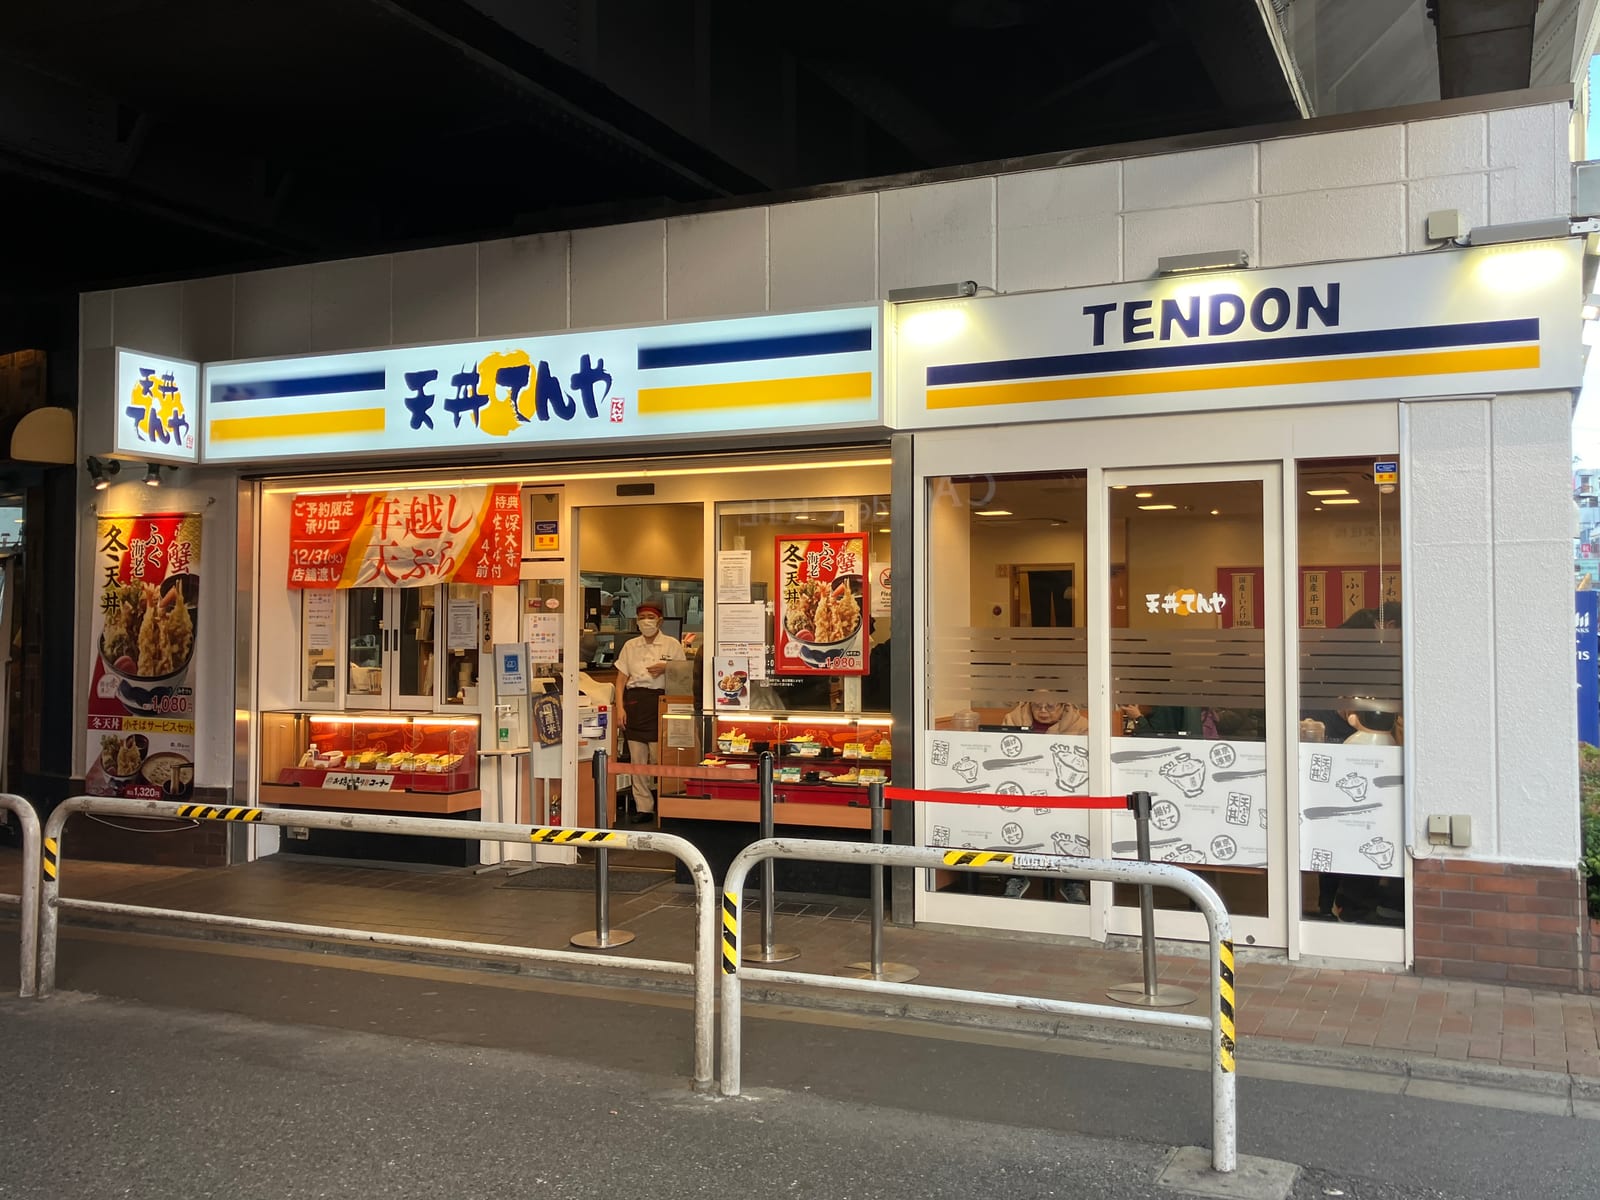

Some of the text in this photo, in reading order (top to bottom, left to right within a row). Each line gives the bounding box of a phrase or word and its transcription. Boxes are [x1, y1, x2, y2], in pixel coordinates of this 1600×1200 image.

[1083, 282, 1340, 347] TENDON
[139, 367, 178, 400] 天丼
[126, 406, 190, 446] てんや
[294, 501, 354, 518] ご予約限定
[366, 493, 474, 542] 年越し
[495, 495, 519, 509] 特典
[305, 518, 340, 535] 承り中
[131, 539, 145, 577] 海老
[145, 524, 164, 568] ふぐ
[168, 541, 192, 575] 蟹
[475, 538, 490, 578] 4人前
[819, 541, 836, 572] ふぐ
[99, 524, 128, 615] 冬天丼
[291, 567, 341, 582] 店舗渡し
[363, 540, 456, 585] 天ぷら
[782, 543, 805, 605] 冬天丼
[807, 551, 820, 577] 海老
[836, 551, 856, 574] 蟹
[93, 717, 195, 734] 冬天丼 小そばサービスセット
[1311, 756, 1321, 779] 天丼
[1153, 804, 1172, 817] 揚げ
[1157, 815, 1176, 827] たて
[1228, 794, 1239, 821] 天丼
